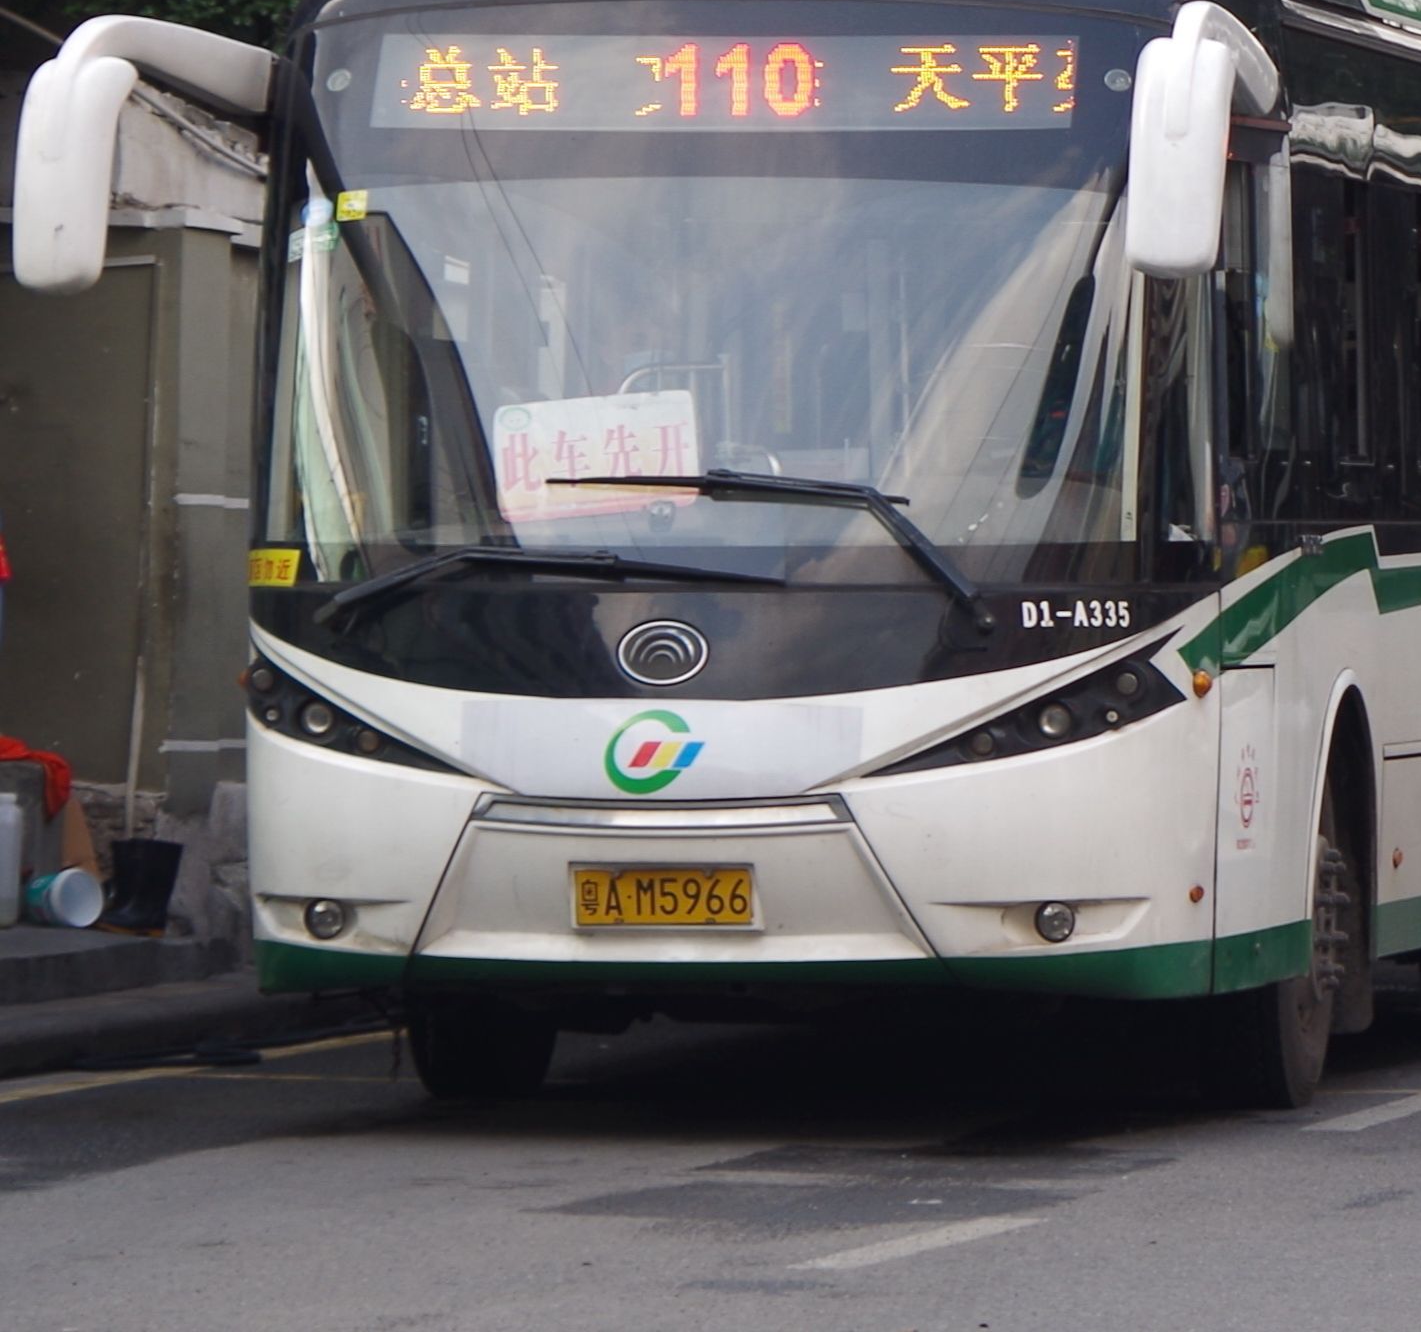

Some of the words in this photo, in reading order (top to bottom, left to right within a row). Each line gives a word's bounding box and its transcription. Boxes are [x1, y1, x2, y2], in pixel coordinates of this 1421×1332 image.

[409, 45, 559, 115] 总站
[664, 42, 815, 117] 110
[502, 421, 690, 492] 此车先开
[1021, 600, 1131, 628] D1-A335
